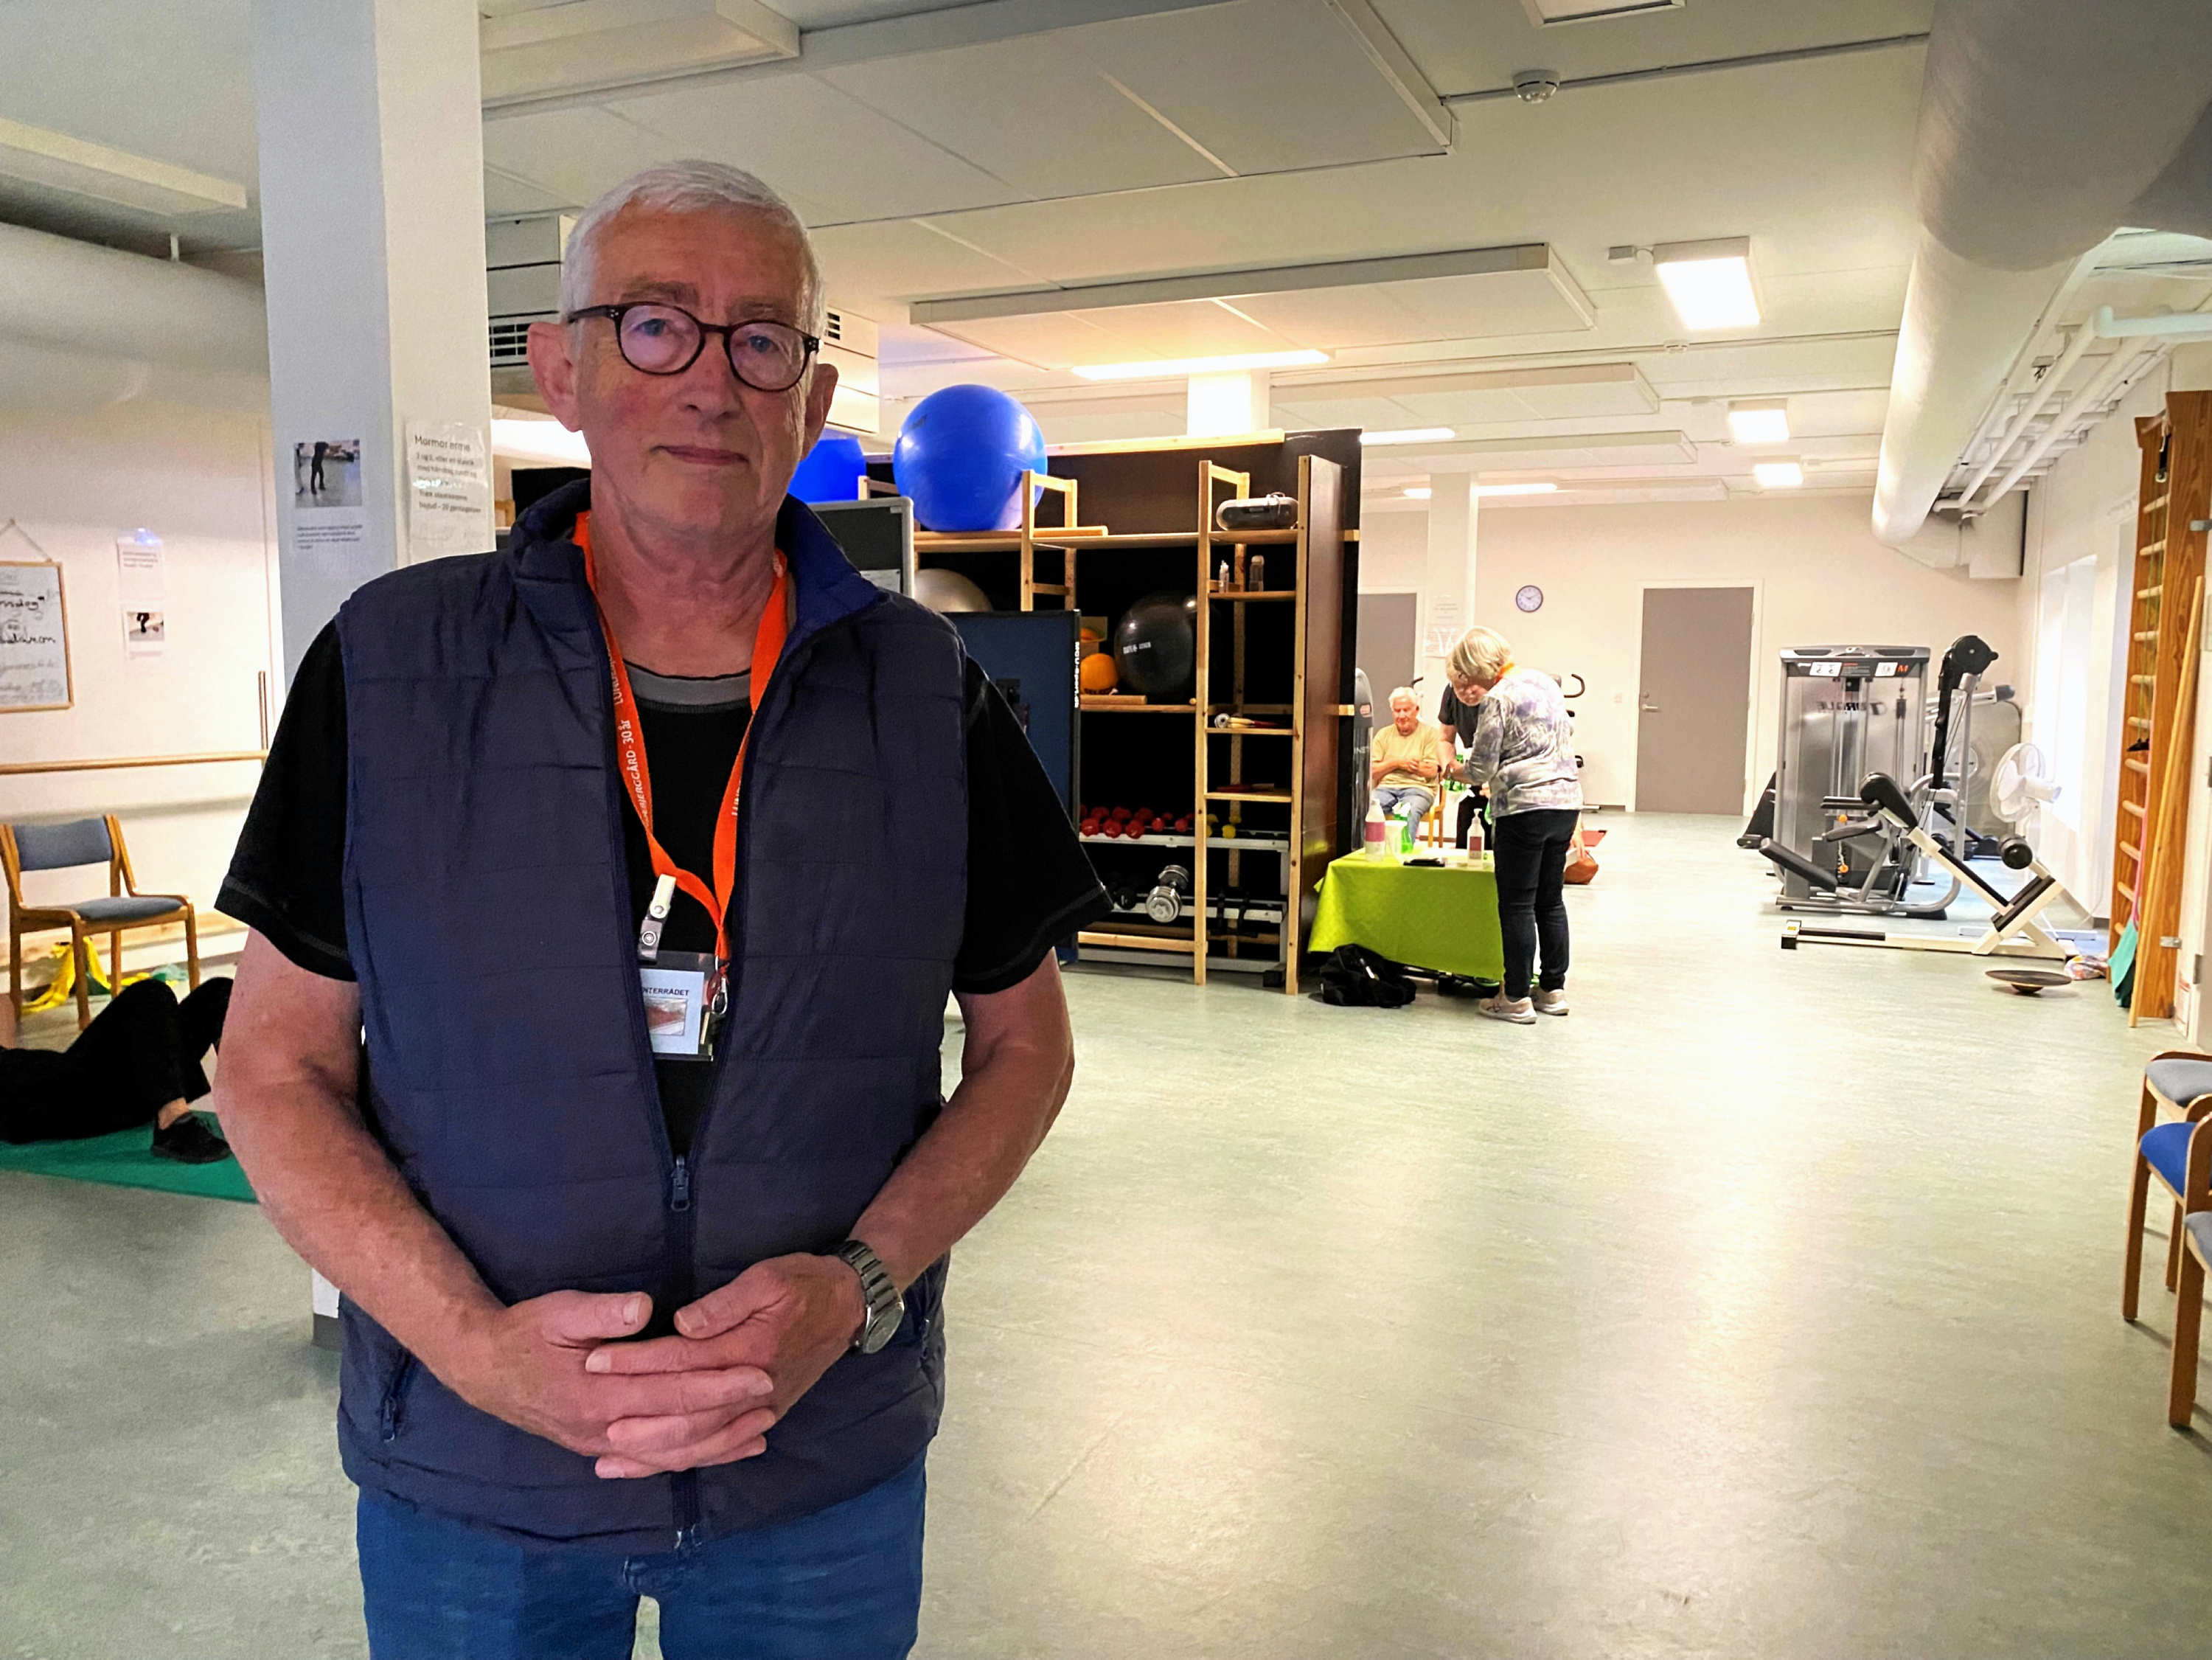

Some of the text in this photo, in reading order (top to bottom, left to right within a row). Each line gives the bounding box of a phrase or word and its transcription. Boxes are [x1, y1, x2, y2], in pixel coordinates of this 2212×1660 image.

[414, 434, 448, 448] Mormor
[618, 720, 631, 730] år
[621, 730, 634, 745] 30
